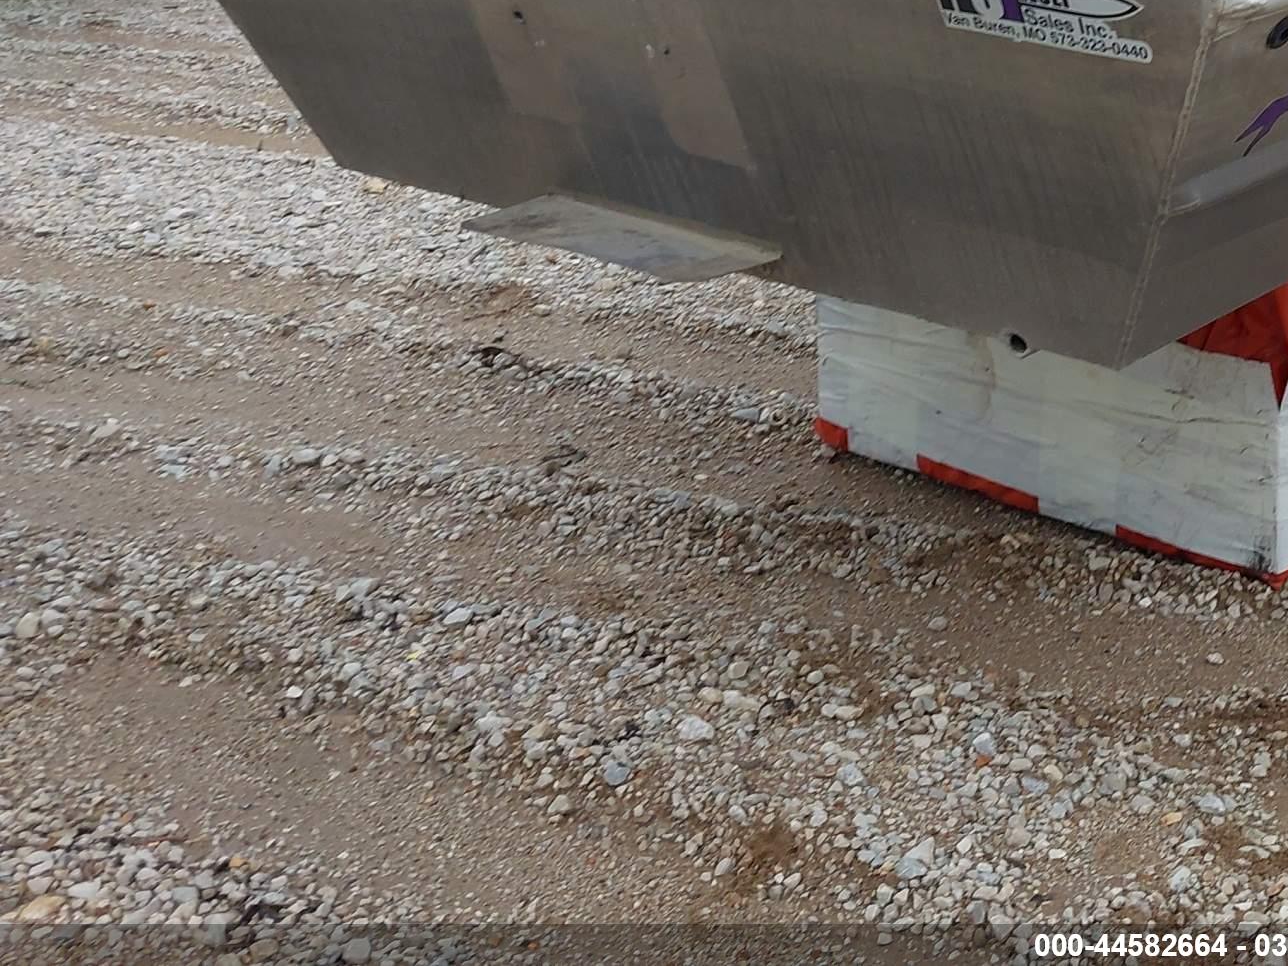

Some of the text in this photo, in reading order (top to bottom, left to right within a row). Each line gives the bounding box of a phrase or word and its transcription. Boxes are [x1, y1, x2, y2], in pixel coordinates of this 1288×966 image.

[1023, 8, 1114, 39] Sales Inc.
[1023, 25, 1046, 42] MO
